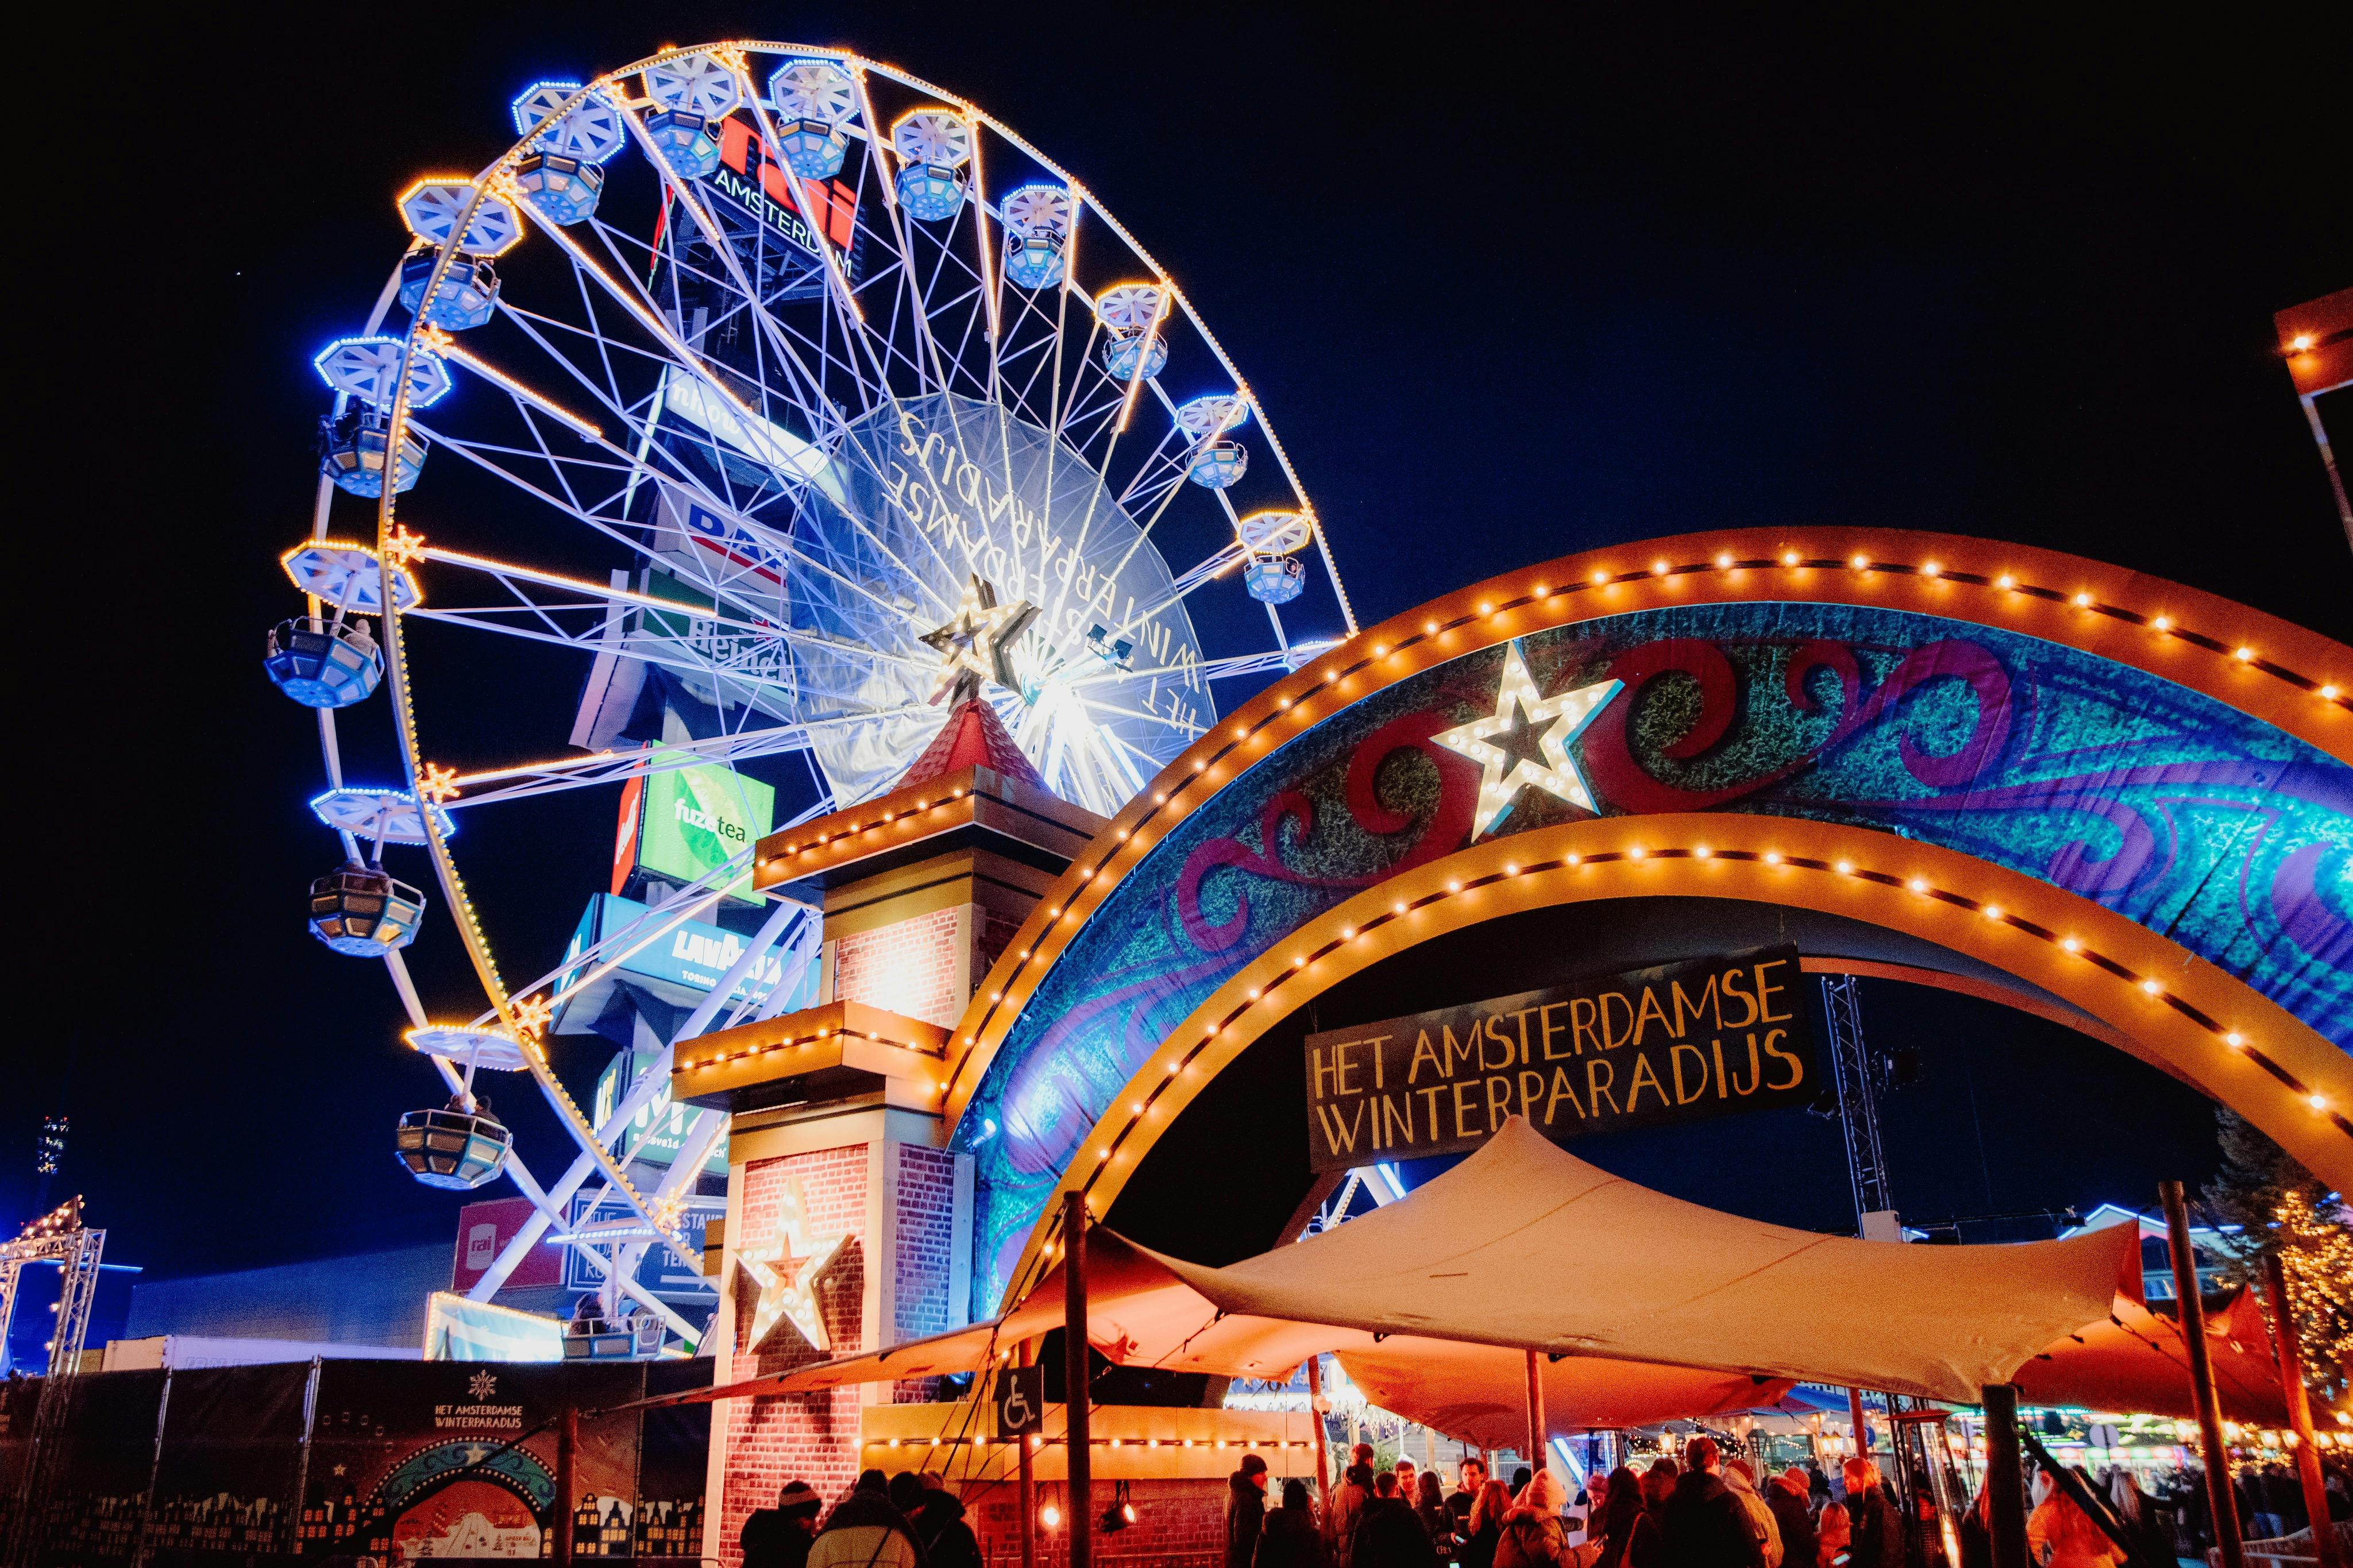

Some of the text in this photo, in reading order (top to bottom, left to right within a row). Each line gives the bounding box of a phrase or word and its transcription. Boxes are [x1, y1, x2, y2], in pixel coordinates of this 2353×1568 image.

[715, 169, 851, 277] AMSTERDM
[1142, 677, 1197, 740] HET
[1313, 960, 1793, 1099] HET AMSTERDAMSE
[1316, 1029, 1803, 1154] WINTERPARADIJS
[472, 1235, 492, 1252] rai
[435, 1405, 523, 1416] HET AMSTERDAMSE
[435, 1416, 522, 1429] WINTERPARADIJS
